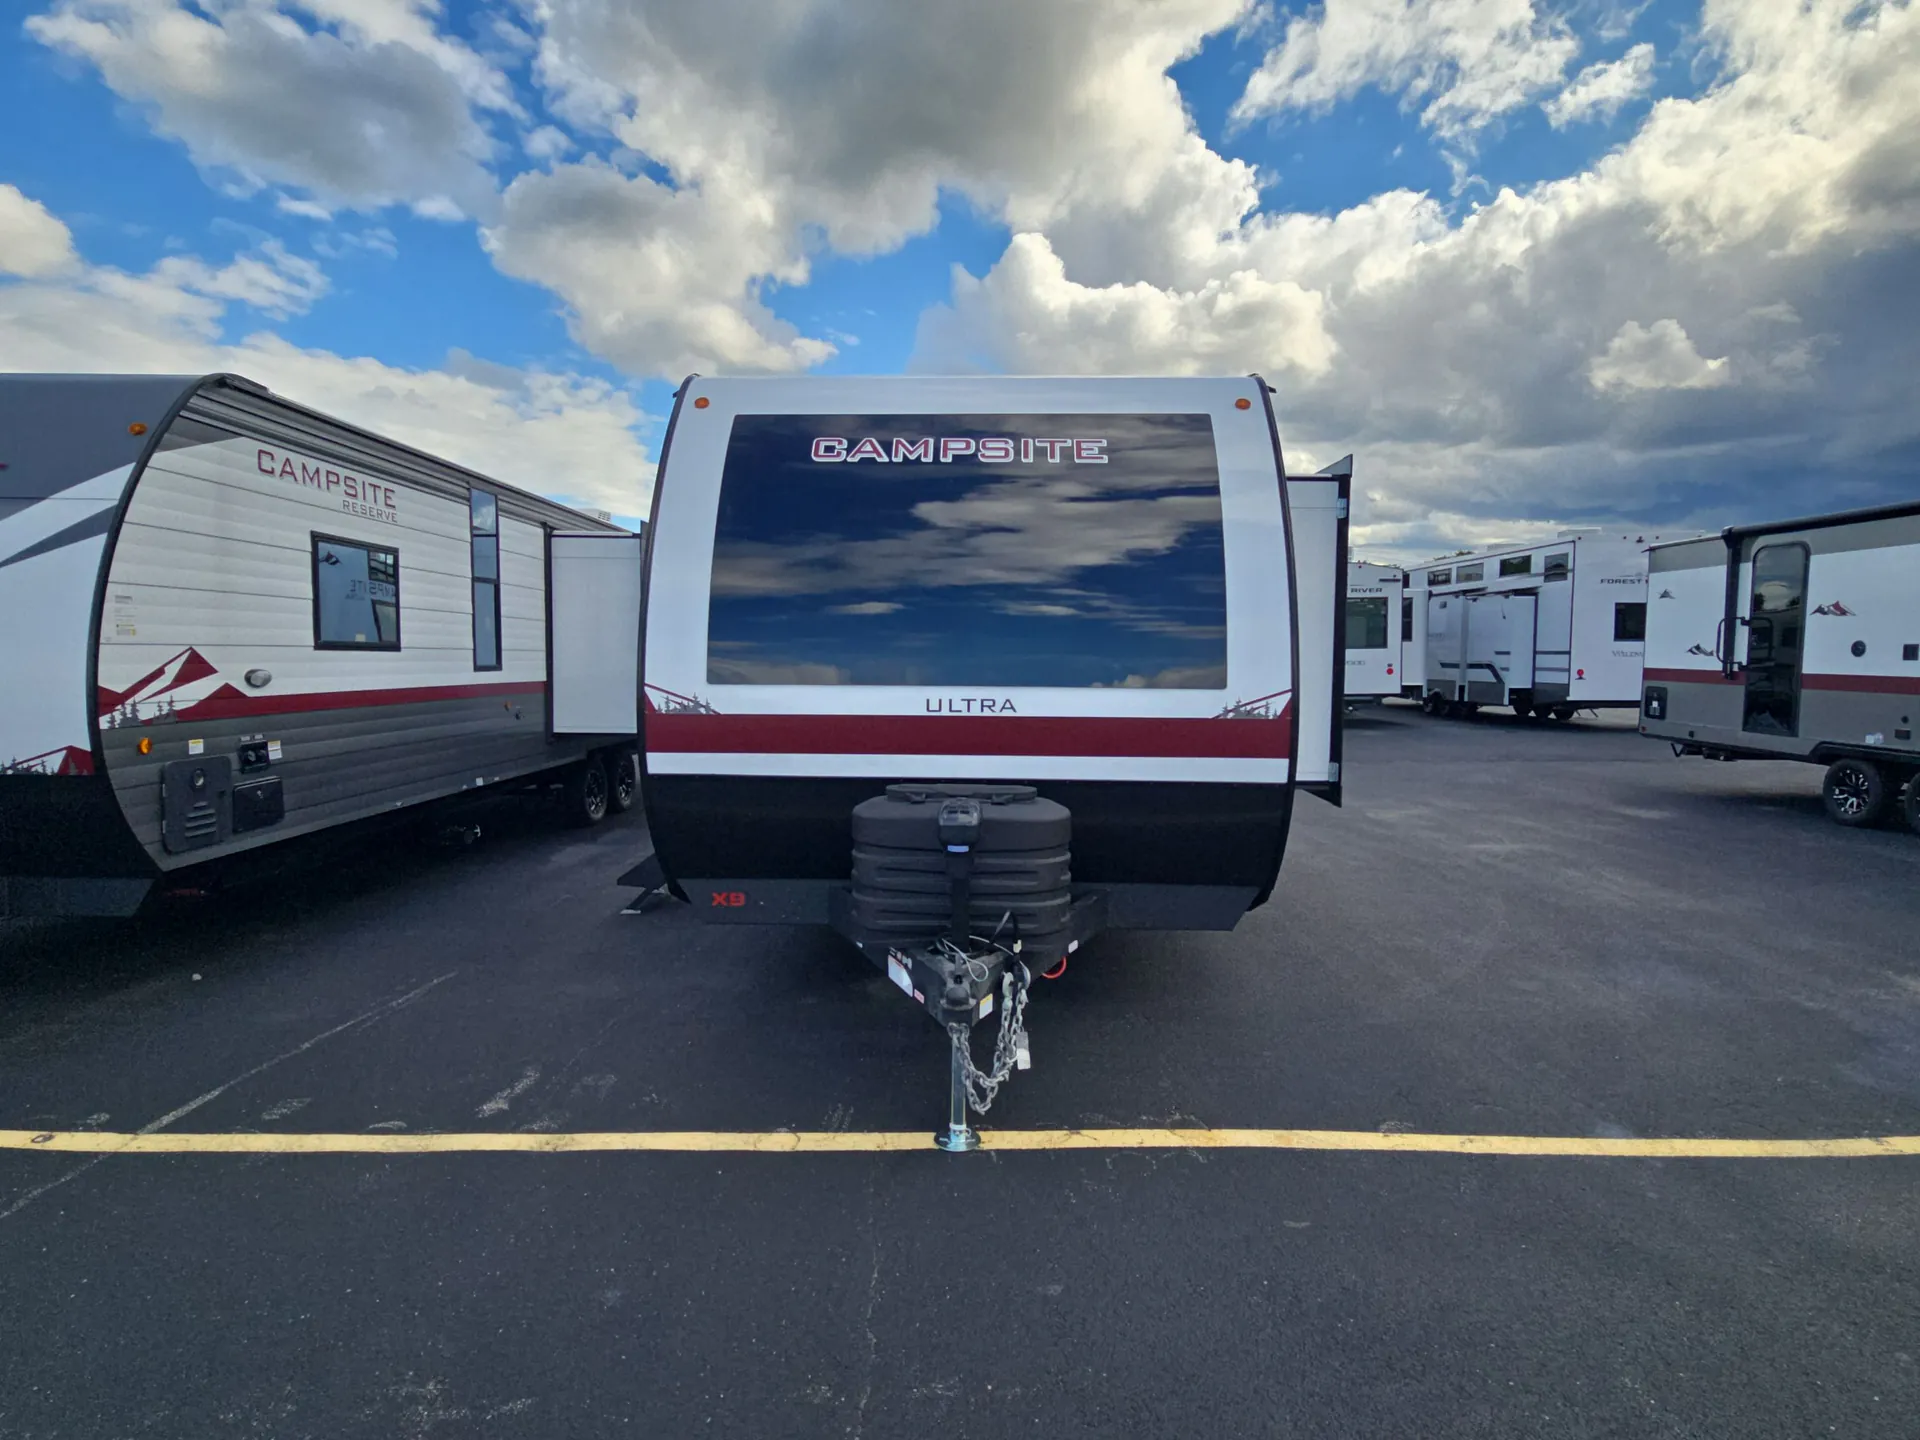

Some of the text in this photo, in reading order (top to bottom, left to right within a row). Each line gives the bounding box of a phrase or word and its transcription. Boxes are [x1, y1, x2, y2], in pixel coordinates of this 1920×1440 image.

[811, 437, 1108, 463] CAMPSITE
[257, 449, 397, 510] CAMPSITE
[342, 499, 398, 524] RESERVE
[926, 698, 1017, 713] ULTRA
